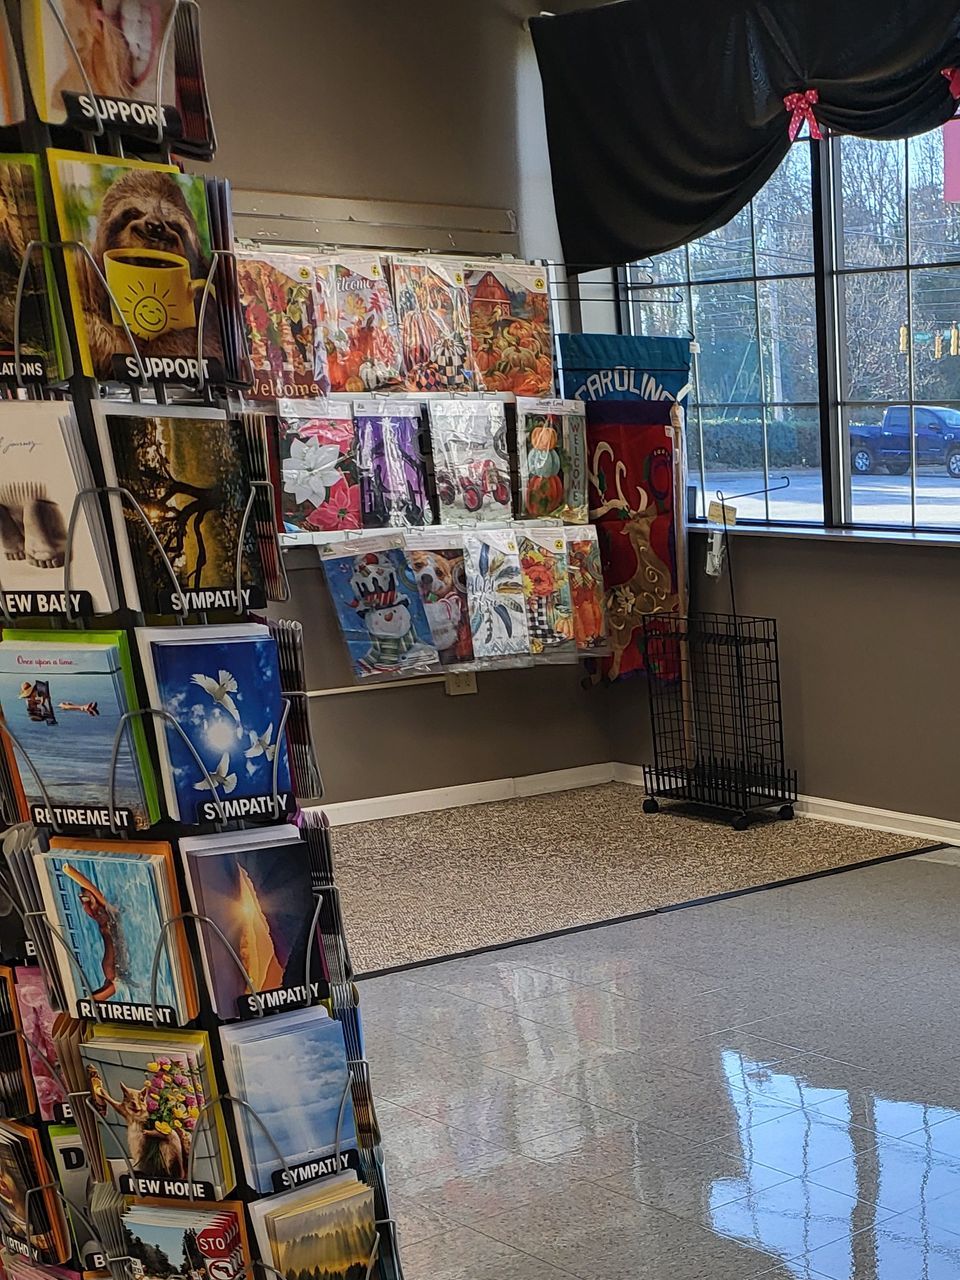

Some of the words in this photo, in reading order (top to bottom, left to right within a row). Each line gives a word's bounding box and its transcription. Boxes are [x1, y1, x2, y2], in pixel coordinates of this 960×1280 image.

[78, 96, 168, 127] SUPPORT
[125, 356, 209, 379] SUPPORT
[571, 422, 580, 502] WELCOME
[0, 594, 32, 612] EW
[37, 594, 80, 612] BABY
[171, 589, 250, 611] SYMPATHY
[16, 655, 33, 665] Once
[35, 659, 51, 668] upon
[34, 808, 128, 826] RETIREMENT
[203, 794, 288, 820] SYMPATHY
[247, 982, 319, 1012] SYMPATHY
[281, 1153, 349, 1186] SYMPATHY
[128, 1178, 160, 1194] NEW
[164, 1181, 205, 1197] HOME
[200, 1237, 226, 1250] STO
